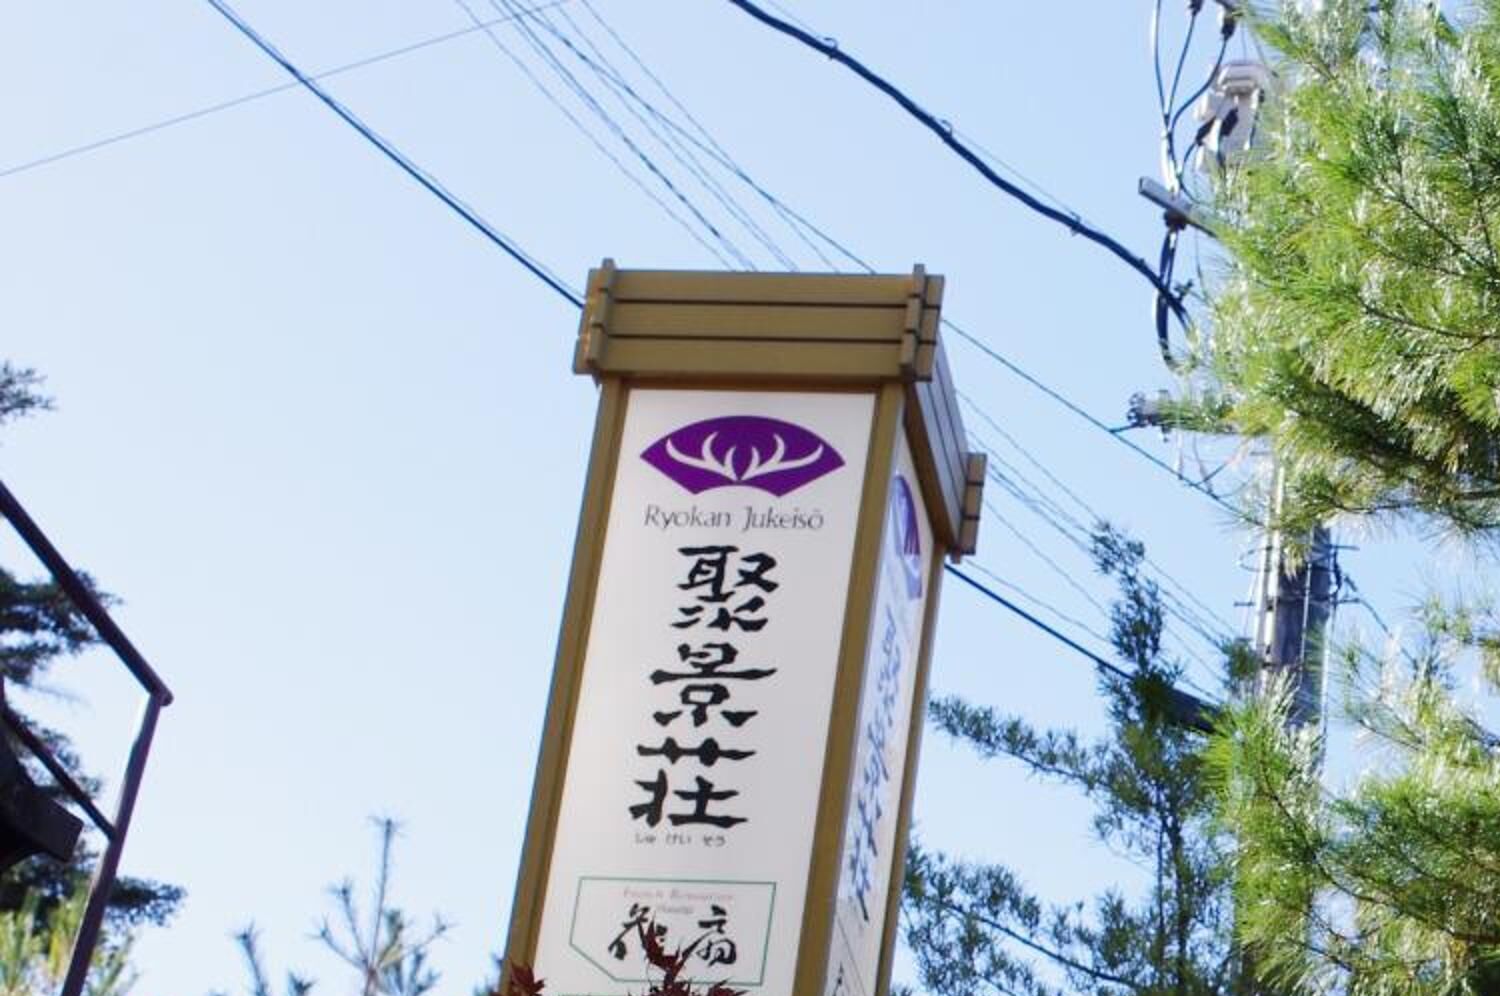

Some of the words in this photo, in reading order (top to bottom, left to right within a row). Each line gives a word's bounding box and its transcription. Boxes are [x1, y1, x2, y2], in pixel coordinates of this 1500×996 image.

[644, 504, 731, 531] Ryokan
[628, 545, 779, 828] 聚景荘
